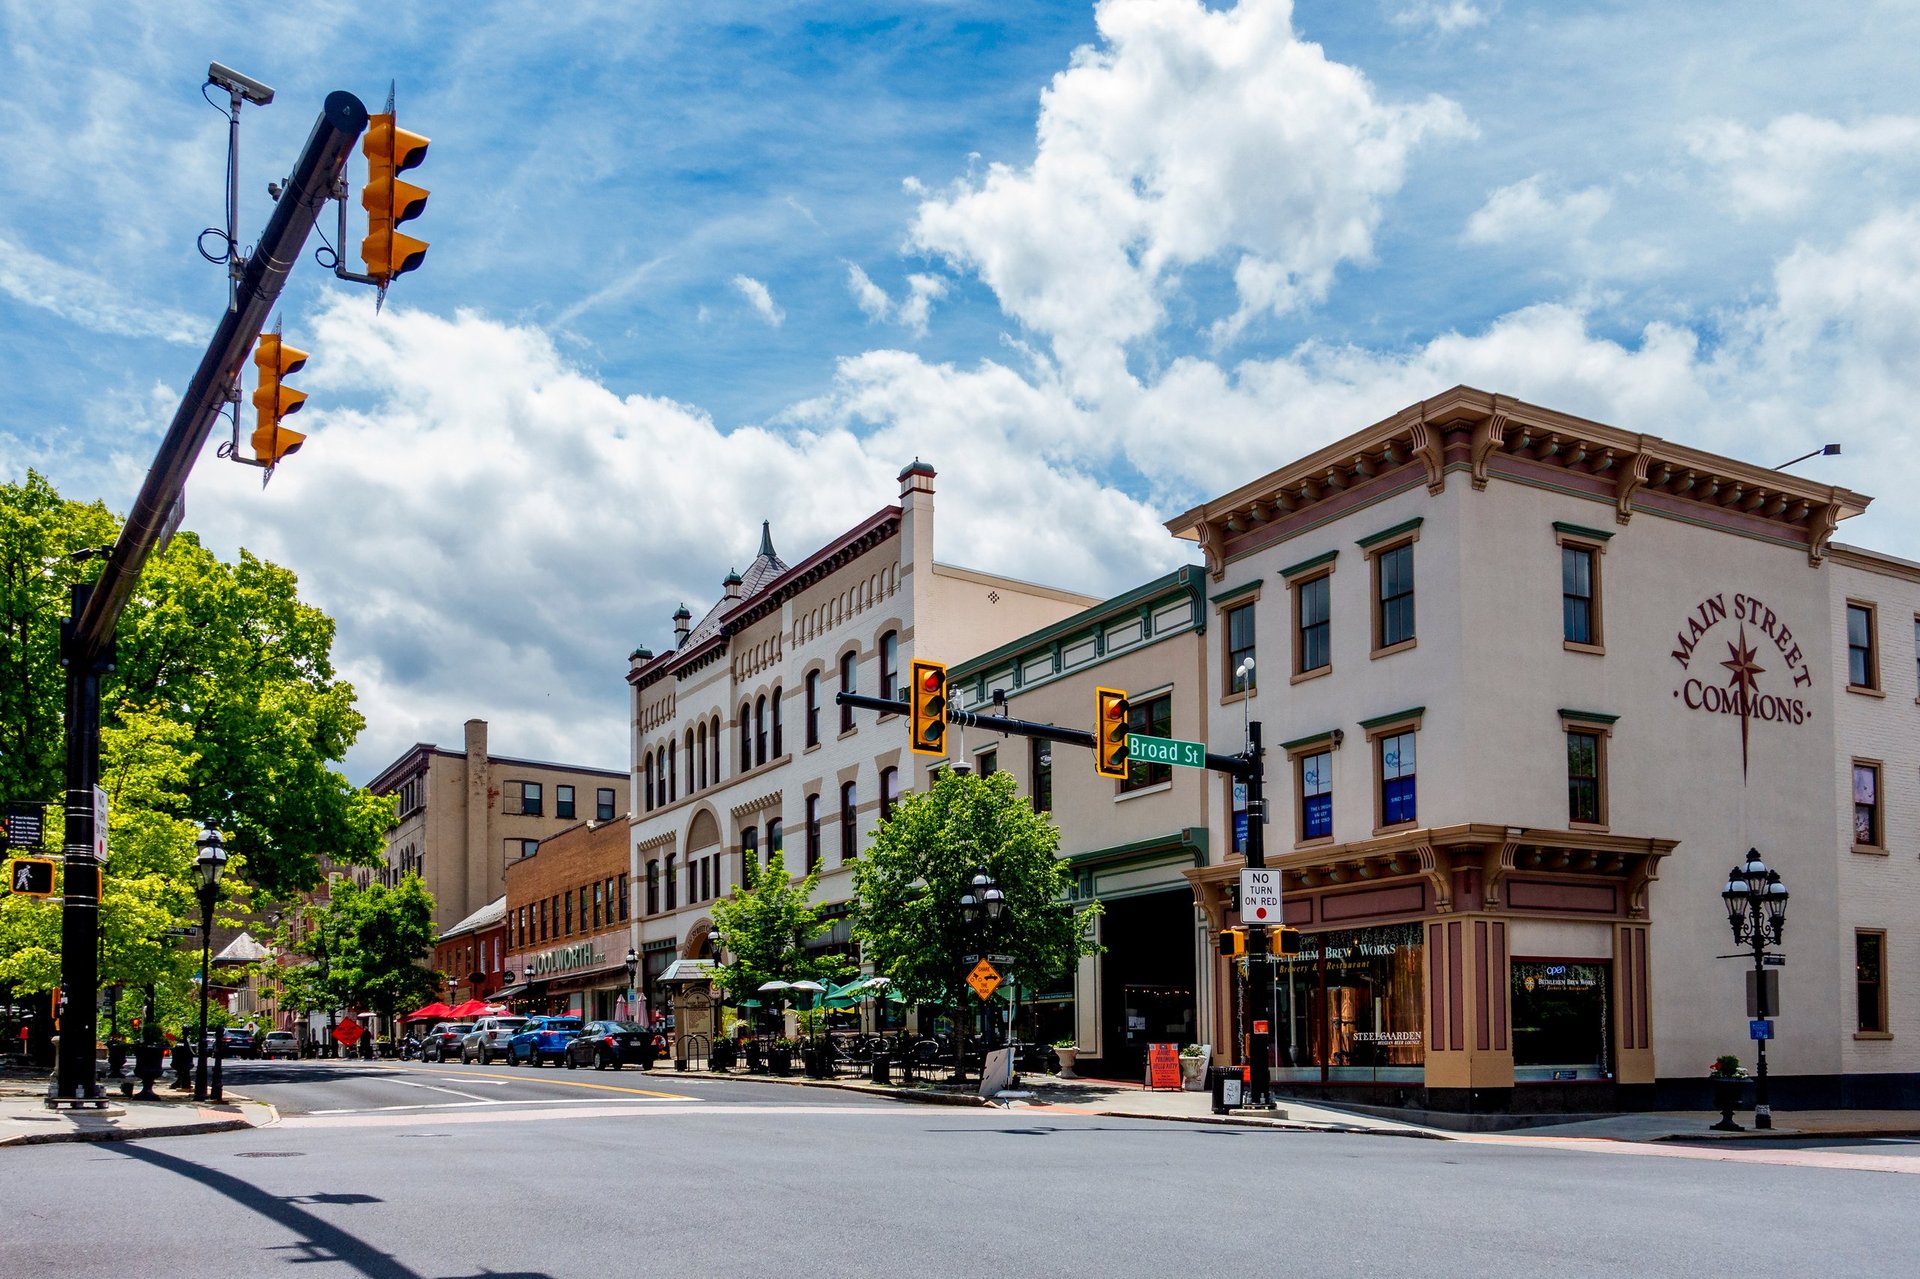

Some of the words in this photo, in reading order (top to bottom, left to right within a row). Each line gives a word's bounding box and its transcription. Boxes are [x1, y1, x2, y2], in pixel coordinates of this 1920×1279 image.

[1671, 593, 1727, 670] MAIN
[1734, 593, 1812, 688] STREET
[1684, 678, 1803, 725] COMMONS
[1130, 738, 1178, 761] Broad
[1185, 745, 1199, 764] St
[1253, 873, 1269, 883] NO
[1250, 886, 1272, 894] TURN
[1245, 897, 1256, 905] ON
[1261, 897, 1277, 906] RED
[1325, 946, 1352, 959] BREW
[1359, 943, 1396, 957] WORKS
[1313, 963, 1318, 971] &
[1326, 961, 1369, 971] Restaurant
[1546, 966, 1566, 975] open
[1353, 1032, 1421, 1041] STEELGAARDEN
